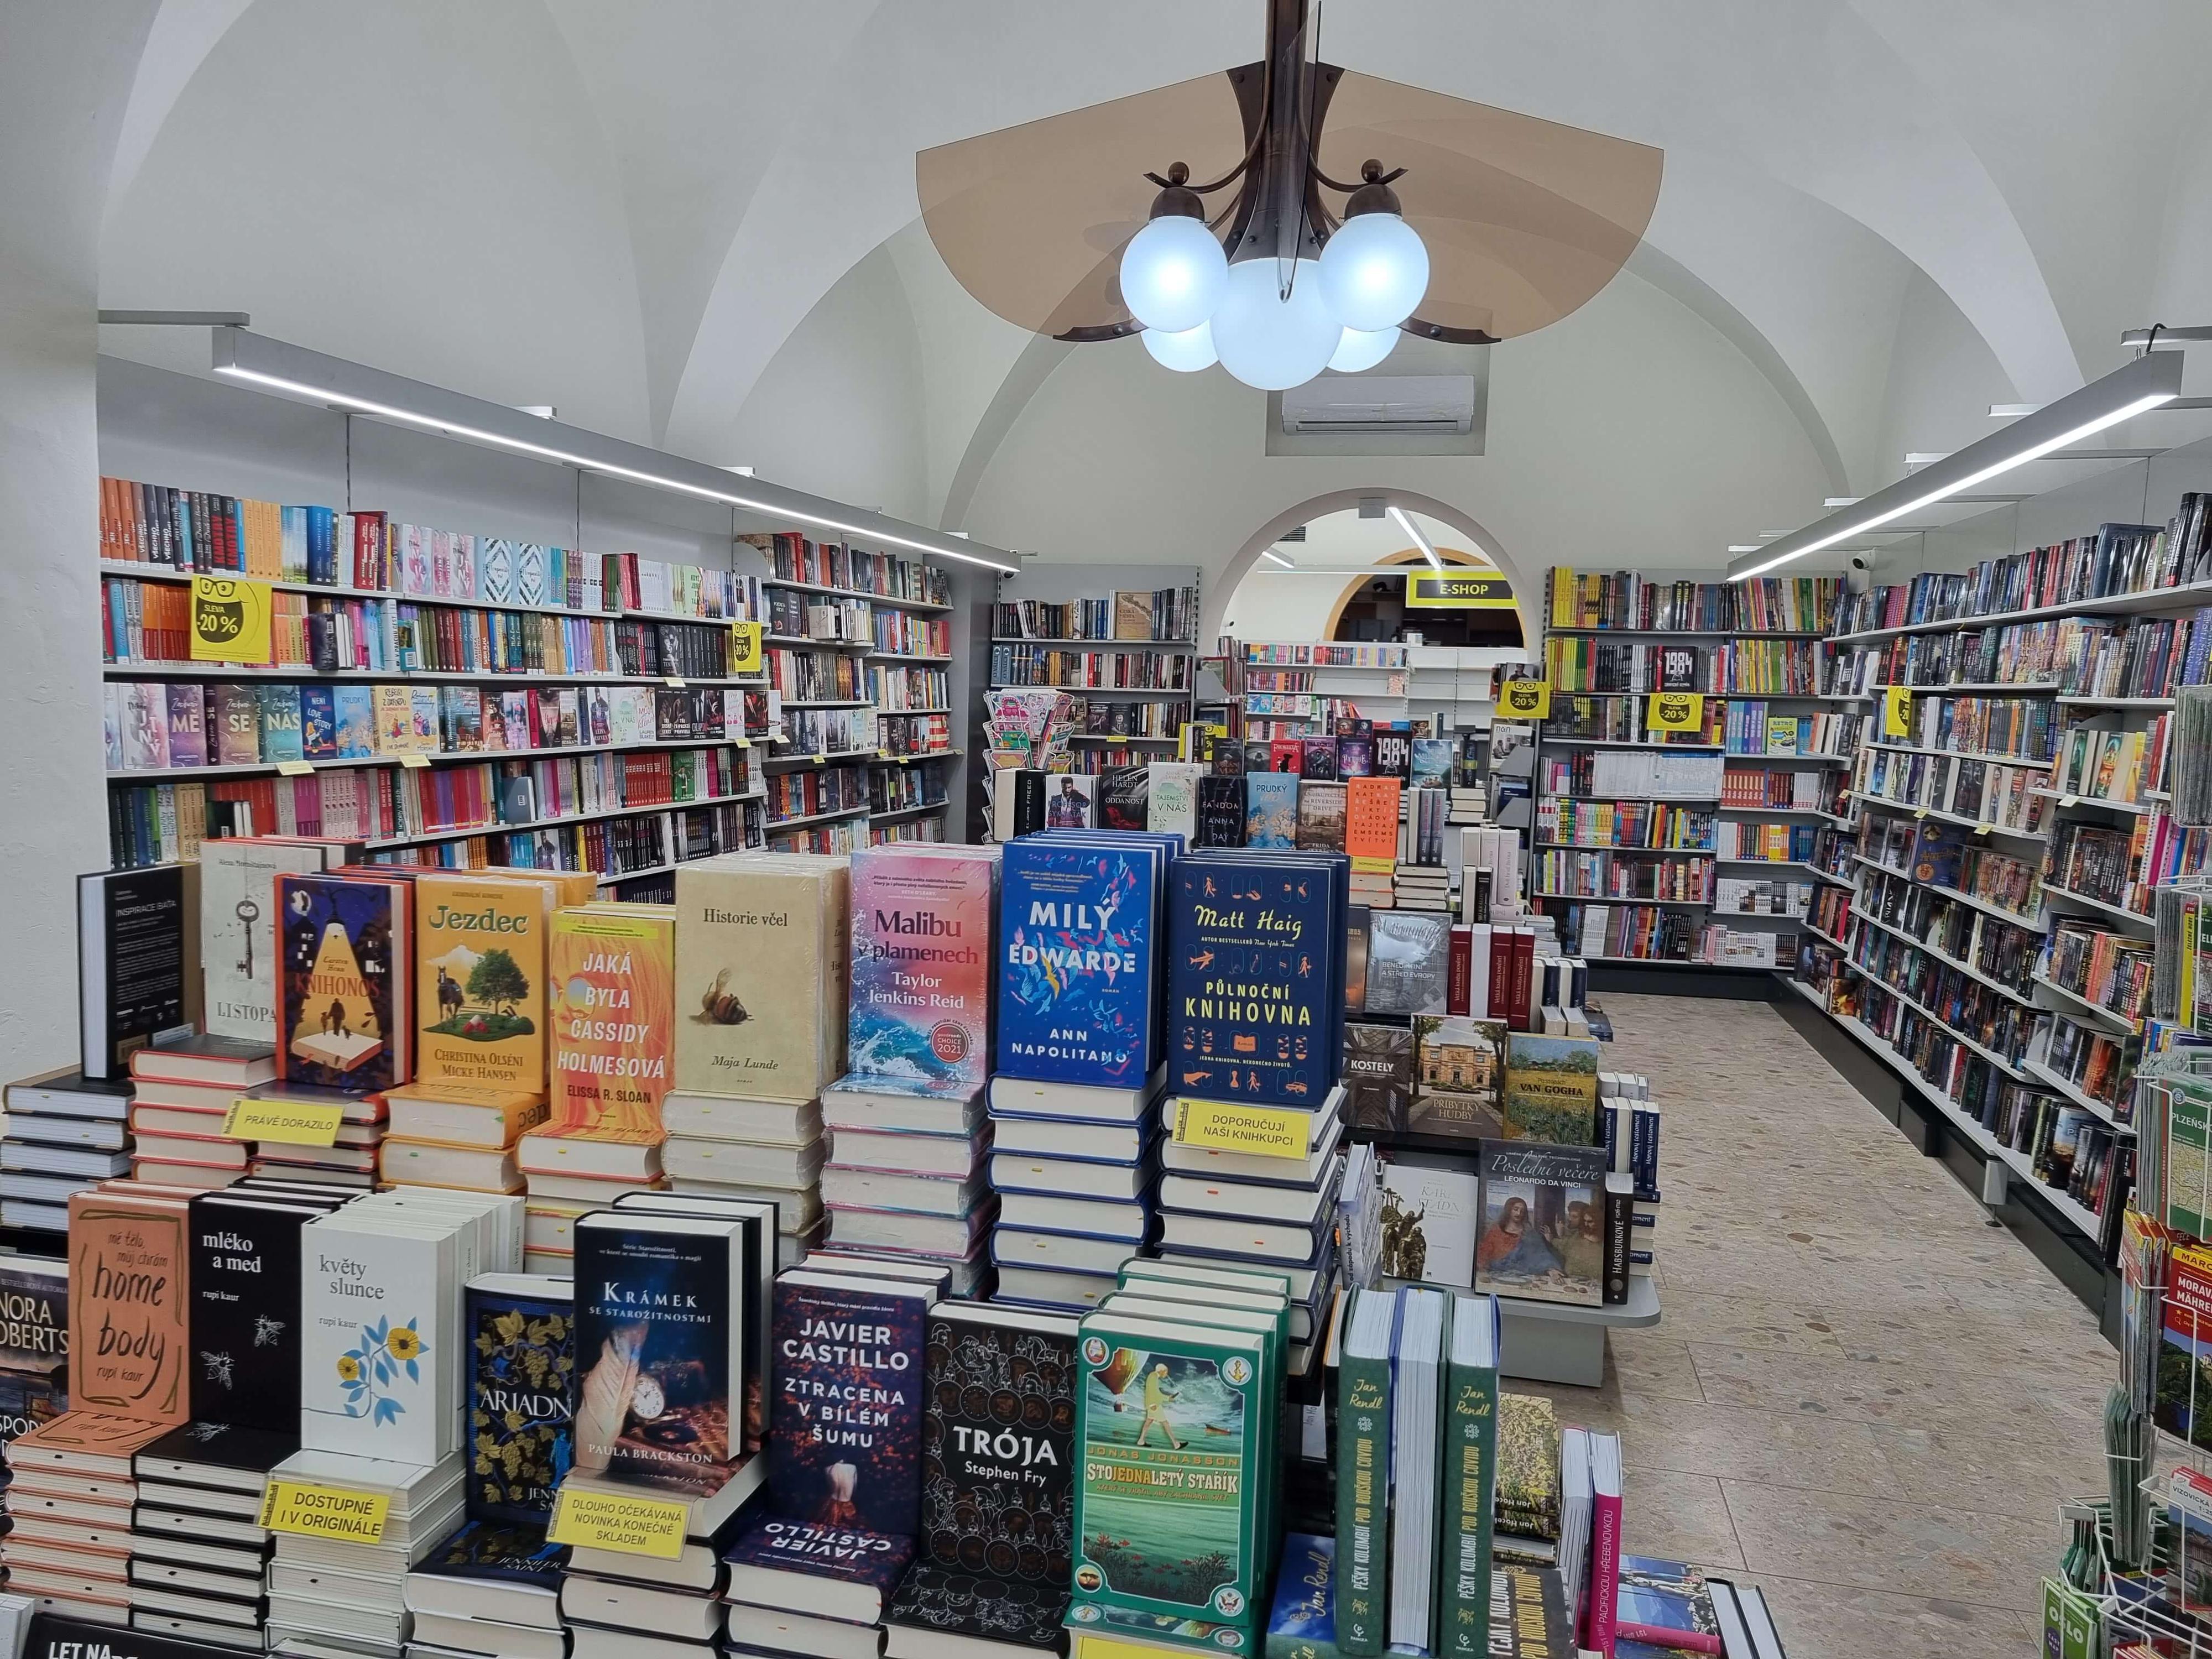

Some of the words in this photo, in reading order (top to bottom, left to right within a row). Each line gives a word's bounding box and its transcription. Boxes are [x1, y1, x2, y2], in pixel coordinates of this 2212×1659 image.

[1439, 584, 1488, 595] E-SHOP
[204, 604, 225, 614] SLEVA
[197, 614, 217, 632] -20
[221, 617, 238, 633] %
[743, 645, 749, 655] %
[1665, 651, 1693, 675] 1984
[1511, 698, 1526, 707] -20
[1528, 698, 1536, 707] %
[229, 713, 250, 732] SE
[267, 708, 300, 731] NÁS
[308, 708, 322, 719] LOVE
[1661, 710, 1677, 719] -20
[1678, 711, 1687, 719] %
[314, 719, 332, 730] STORY
[1377, 734, 1408, 765] 1984
[1256, 784, 1287, 793] PRUDKÝ
[1157, 804, 1165, 812] V
[1166, 802, 1187, 812] NÁS
[1212, 833, 1228, 841] DAY
[116, 904, 156, 917] INSPIRACE
[429, 905, 529, 935] Jezdec
[703, 908, 758, 925] Historie
[761, 911, 788, 927] včel
[1029, 898, 1117, 931] MILÝ
[875, 909, 962, 938] Malibu
[1194, 905, 1245, 930] Matt
[1256, 909, 1303, 940] Haig
[582, 952, 632, 974] JAKÁ
[872, 940, 978, 965] plamenech
[1008, 944, 1136, 973] EDWARDE
[891, 971, 942, 988] Taylor
[1206, 978, 1290, 1000] PŮLNOČNÍ
[584, 988, 630, 1009] BYLA
[869, 989, 926, 1006] Jenkins
[929, 993, 964, 1009] Reid
[1186, 997, 1311, 1026] KNIHOVNA
[570, 1019, 649, 1044] CASSIDY
[1050, 1029, 1088, 1042] ANN
[434, 1049, 487, 1063] CHRISTINA
[489, 1052, 523, 1067] OLSÉNI
[938, 1044, 961, 1054] 2021
[1012, 1044, 1128, 1065] NAPOLITANO
[557, 1051, 665, 1079] HOLMESOVÁ
[711, 1055, 740, 1069] Maja
[744, 1057, 779, 1070] Lunde
[1350, 1059, 1394, 1073] KOSTELY
[442, 1066, 473, 1078] MICKE
[477, 1067, 517, 1081] HANSEN
[567, 1085, 600, 1099] ELISSA
[603, 1088, 613, 1100] R.
[616, 1089, 651, 1104] SLOAN
[1520, 1083, 1541, 1092] VAN
[1544, 1086, 1583, 1096] GOGHA
[1433, 1098, 1481, 1112] PŘÍBYTKY
[1438, 1109, 1474, 1121] HUDBY
[281, 1118, 333, 1130] DORAZILO
[1212, 1114, 1286, 1133] DOPORUČUJÍ
[1203, 1125, 1230, 1139] NAŠI
[1232, 1130, 1293, 1146] KNIHKUPCI
[1492, 1150, 1556, 1176] Poslední
[1558, 1164, 1600, 1180] večeře
[1504, 1176, 1546, 1185] LEONARDO
[202, 1231, 253, 1252] mléko
[1613, 1220, 1624, 1274] HABSBURKOVÉ
[212, 1255, 222, 1268] a
[226, 1256, 262, 1273] med
[319, 1254, 367, 1281] květy
[92, 1250, 167, 1307] home
[1349, 1271, 1354, 1281] od
[202, 1290, 220, 1301] rupi
[222, 1291, 240, 1302] kaur
[330, 1277, 385, 1300] slunce
[603, 1282, 697, 1308] KRÁMEK
[0, 1292, 53, 1325] NORA
[589, 1306, 602, 1315] SE
[606, 1308, 711, 1323] STAROŽITNOSTMI
[319, 1317, 336, 1328] rupi
[337, 1318, 358, 1329] kaur
[800, 1318, 891, 1345] JAVIER
[97, 1308, 165, 1400] body
[782, 1339, 909, 1371] CASTILLO
[96, 1365, 118, 1380] rupi
[122, 1365, 144, 1382] kaur
[785, 1377, 905, 1406] ZTRACENA
[1354, 1378, 1379, 1392] Jan
[1461, 1385, 1486, 1399] Jan
[480, 1389, 573, 1419] ARIADN
[1349, 1394, 1382, 1410] Rendl
[1456, 1401, 1491, 1416] Rendl
[798, 1404, 810, 1416] V
[821, 1405, 889, 1427] BÍLÉM
[812, 1424, 873, 1448] ŠUMU
[952, 1425, 1058, 1466] TRÓJA
[588, 1443, 629, 1459] PAULA
[633, 1448, 713, 1464] BRACKSTON
[1087, 1446, 1139, 1459] JONAS
[1148, 1453, 1238, 1466] JONASSON
[1357, 1438, 1373, 1467] COVIDU
[964, 1461, 1019, 1481] Stephen
[1024, 1470, 1047, 1486] Fry
[1087, 1463, 1184, 1488] STOJEDNALETÝ
[1188, 1470, 1238, 1493] STAŘÍK
[1354, 1469, 1371, 1504] ROUŠKOU
[294, 1492, 375, 1515] DOSTUPNÉ
[572, 1499, 615, 1515] DLOUHO
[618, 1503, 682, 1521] OČEKÁVANÁ
[289, 1513, 300, 1524] V
[301, 1514, 382, 1537] ORIGINÁLE
[575, 1514, 621, 1530] NOVINKA
[1355, 1506, 1371, 1523] POD
[596, 1530, 647, 1546] SKLADEM
[1603, 1510, 1614, 1573] HŘEBENOVKOU
[1304, 1551, 1331, 1588] Rendl
[1302, 1589, 1326, 1617] Jan
[1598, 1574, 1610, 1623] PACIFICKOU
[49, 1642, 82, 1659] LET
[86, 1643, 110, 1659] NA
